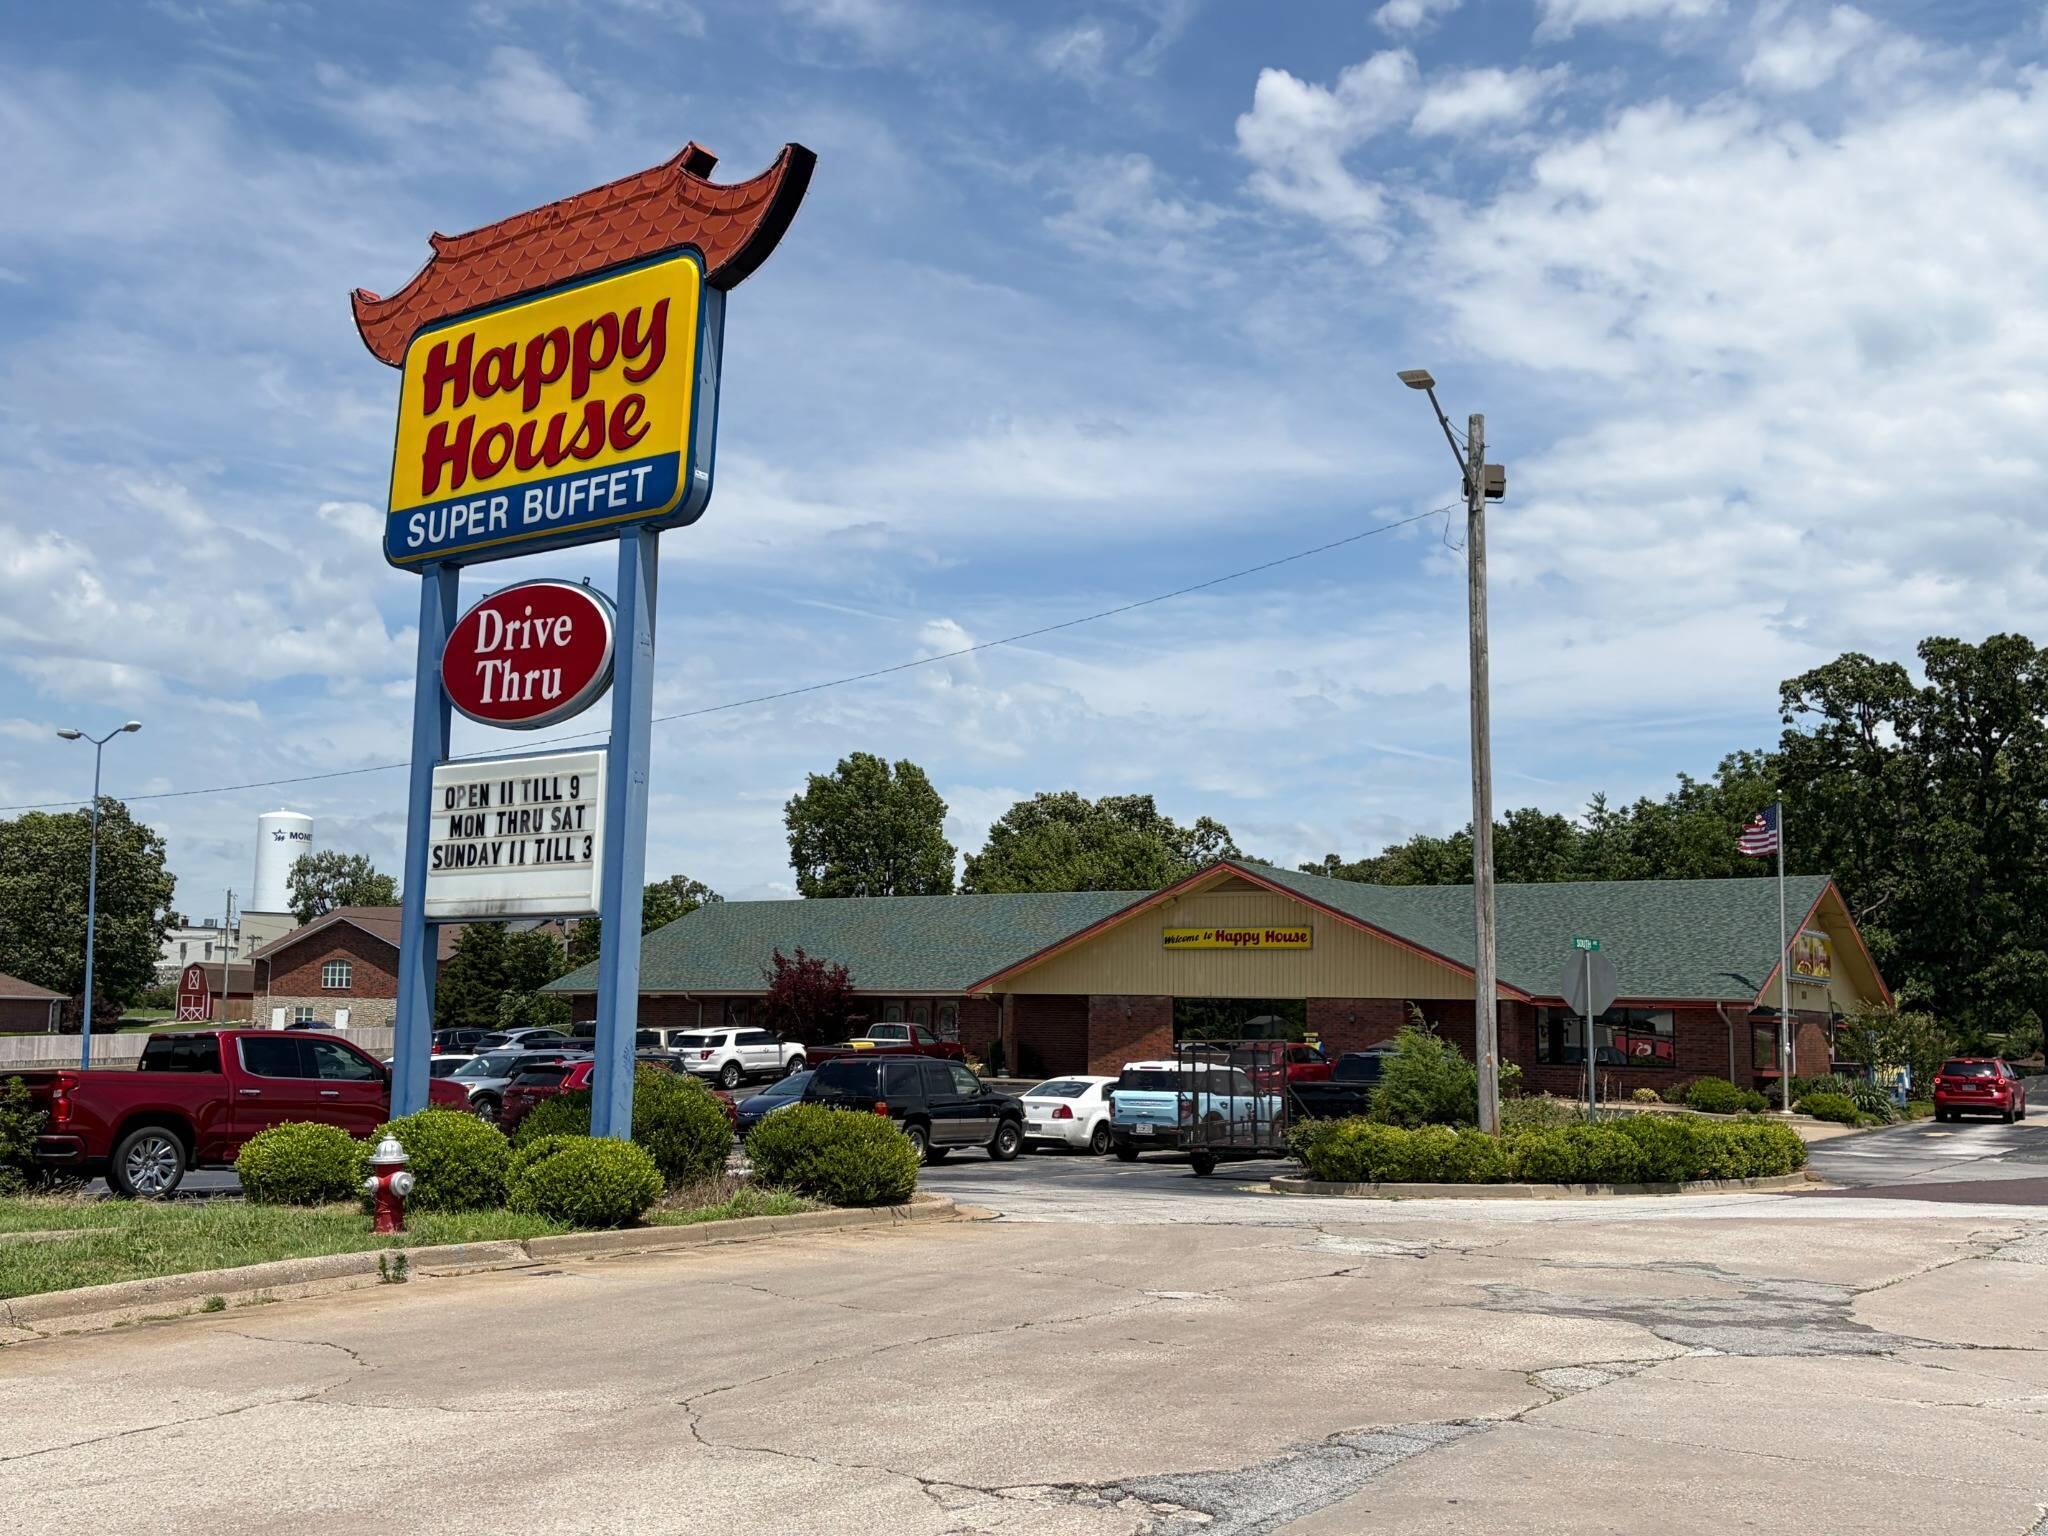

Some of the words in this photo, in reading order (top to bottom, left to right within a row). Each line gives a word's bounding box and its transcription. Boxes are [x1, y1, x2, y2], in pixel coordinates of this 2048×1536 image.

[423, 297, 670, 416] Happy
[421, 393, 651, 497] House
[407, 495, 508, 548] SUPER
[522, 465, 653, 524] BUFFET
[474, 605, 573, 654] Drive
[475, 659, 562, 704] Thru
[445, 783, 490, 809] OPEN
[521, 777, 562, 802] TILL
[570, 775, 580, 799] 9
[450, 813, 486, 838] MON
[497, 808, 544, 834] THRU
[551, 805, 586, 831] SAT
[432, 841, 503, 869] SUNDAY
[535, 837, 575, 862] TILL
[582, 835, 593, 859] 3
[1164, 934, 1200, 945] Welcome
[1203, 931, 1213, 940] to
[1215, 929, 1261, 946] Happy
[1264, 930, 1308, 943] House
